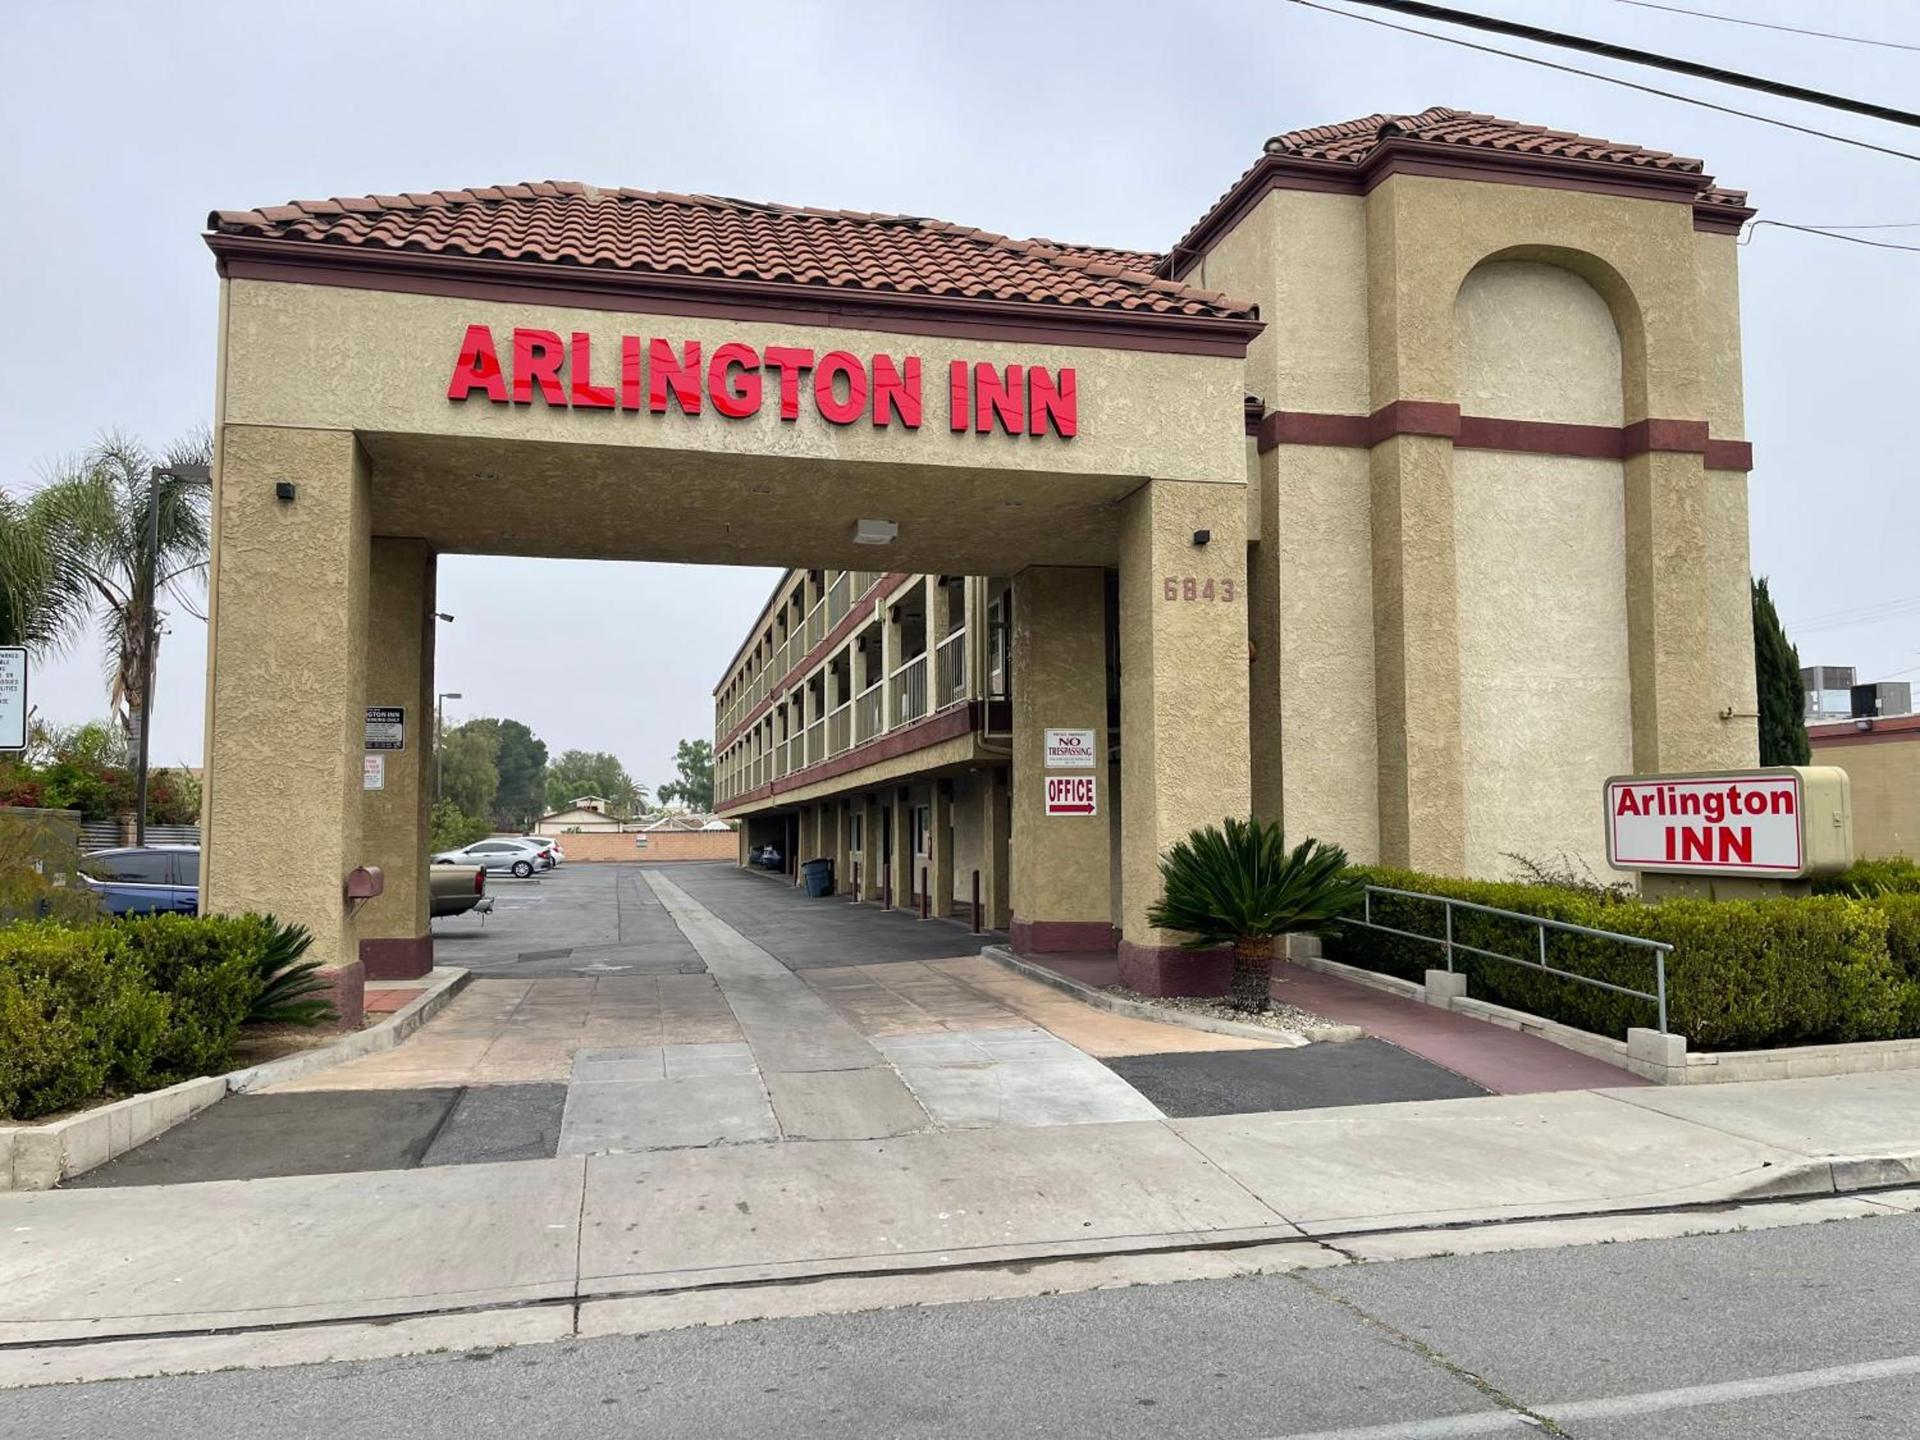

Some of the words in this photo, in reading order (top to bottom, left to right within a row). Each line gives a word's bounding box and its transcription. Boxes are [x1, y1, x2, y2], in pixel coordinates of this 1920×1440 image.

[447, 324, 922, 430] ARLINGTON
[949, 360, 1077, 438] INN
[1164, 576, 1234, 602] 6843
[1048, 746, 1092, 757] TRESPASSING
[1059, 736, 1081, 747] NO
[1048, 779, 1093, 802] OFFICE
[1616, 785, 1795, 824] Arlington
[1664, 826, 1753, 863] INN
